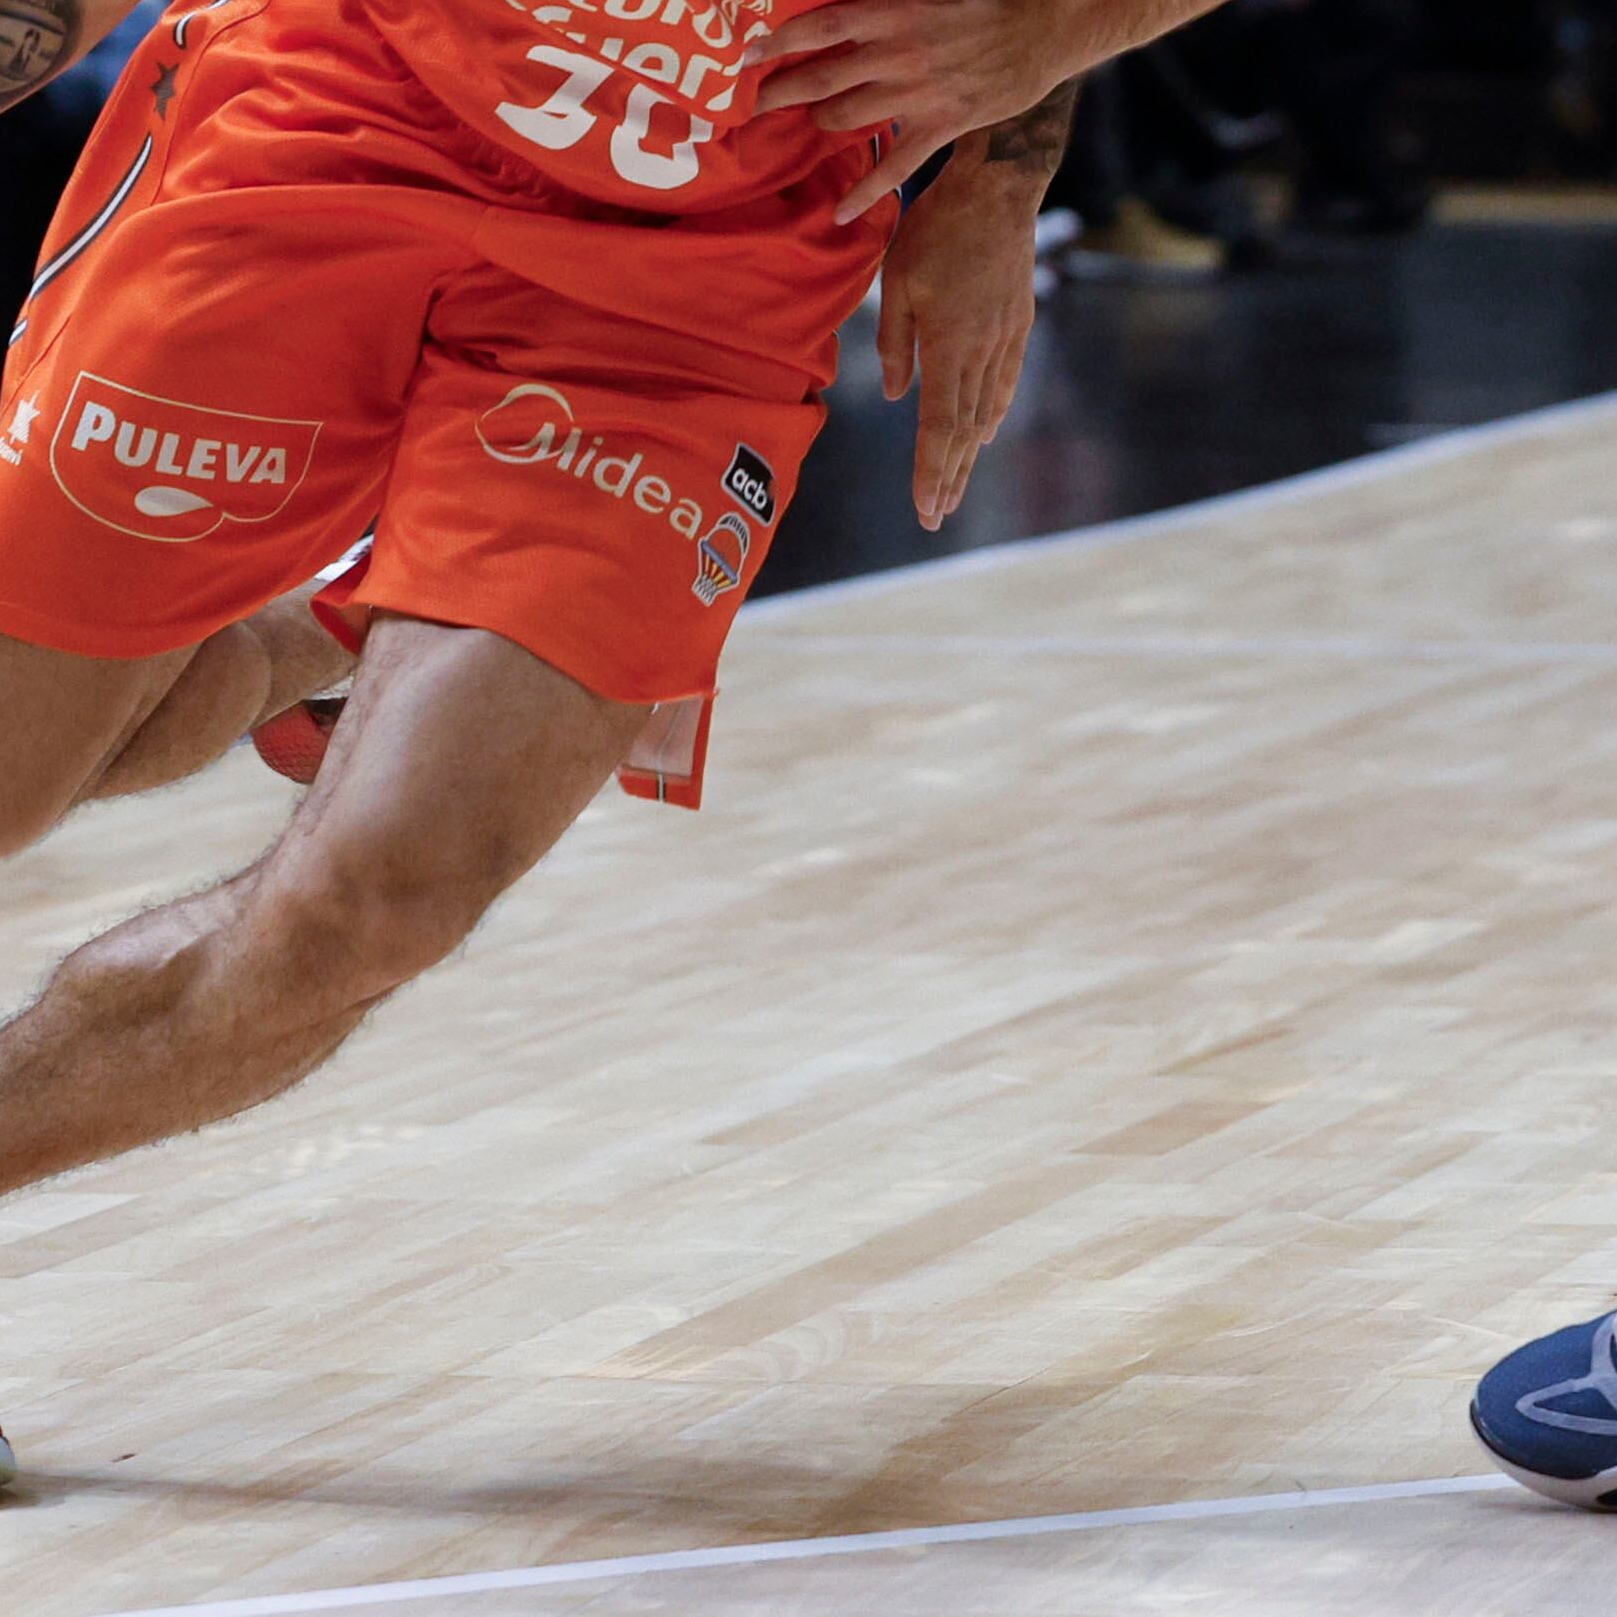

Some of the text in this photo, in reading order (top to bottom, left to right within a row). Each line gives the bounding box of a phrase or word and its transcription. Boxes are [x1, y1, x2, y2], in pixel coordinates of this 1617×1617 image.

[71, 400, 287, 485] PULEVA
[483, 398, 703, 540] Midea
[732, 468, 768, 510] acb
